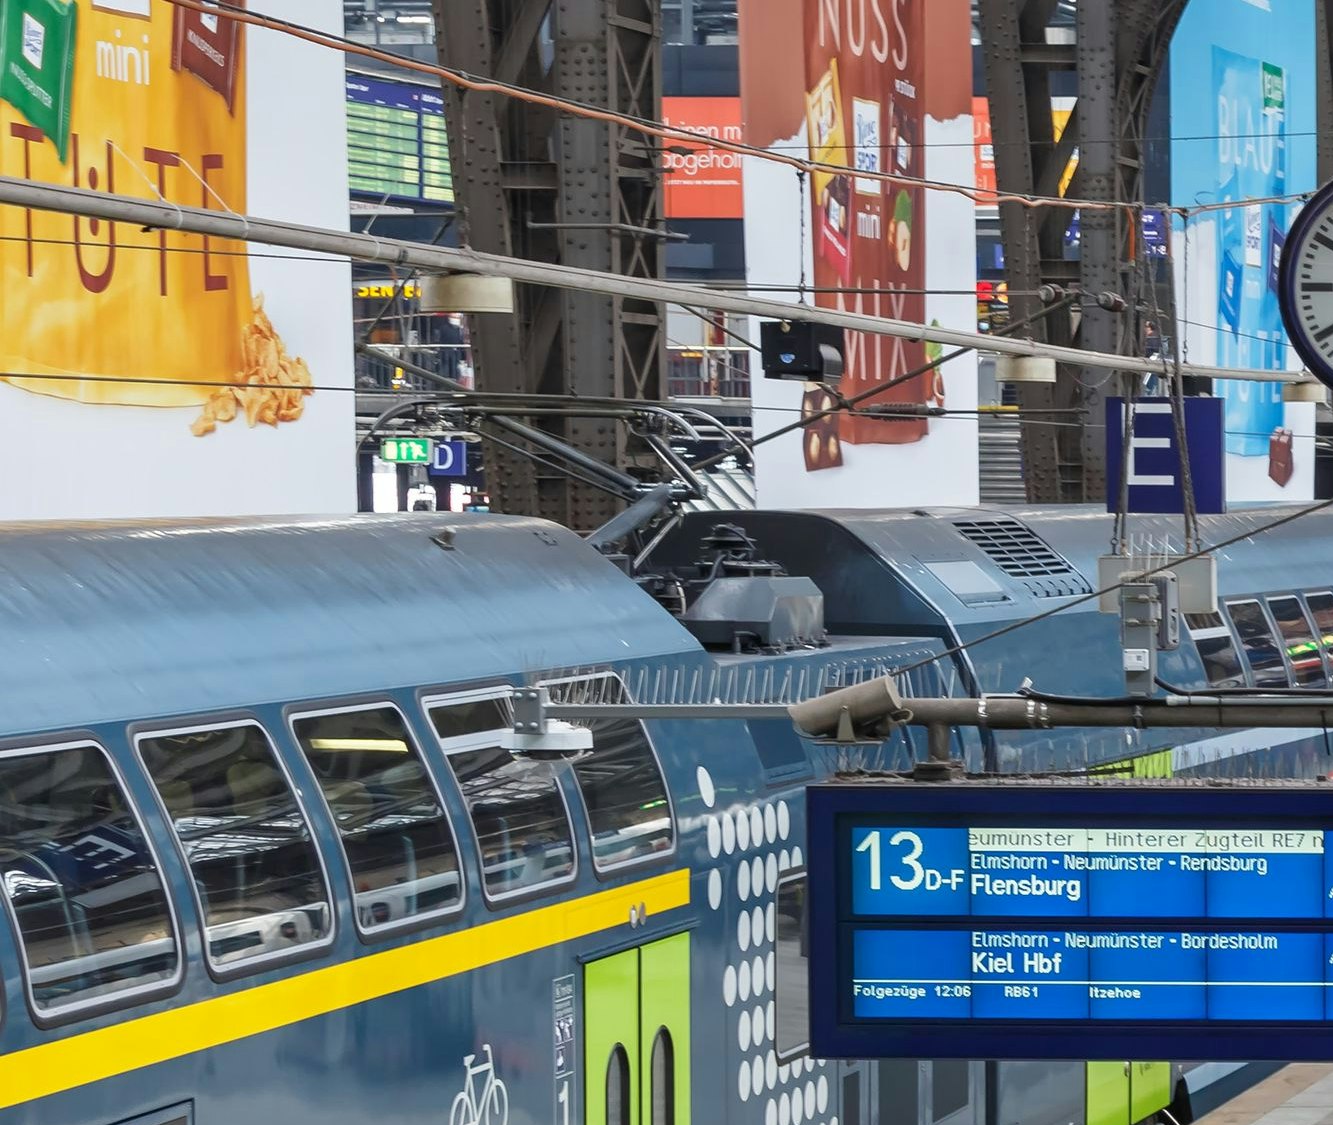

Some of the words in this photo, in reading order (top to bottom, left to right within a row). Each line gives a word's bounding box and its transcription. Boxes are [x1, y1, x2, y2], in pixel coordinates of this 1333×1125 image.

[95, 29, 150, 86] mini
[1127, 404, 1175, 485] E
[434, 444, 453, 470] D
[1105, 831, 1188, 848] Hinterer
[1194, 832, 1264, 853] Zugteil
[1272, 834, 1306, 848] RE7
[855, 830, 925, 891] 13
[924, 869, 965, 892] D-F
[971, 854, 1048, 870] Elmshorn
[1063, 855, 1163, 872] Neumünster
[1180, 856, 1268, 875] Rendsburg
[971, 875, 1081, 900] Flensburg
[972, 931, 1049, 948] Elmshorn
[1065, 932, 1164, 949] Neumünster
[1181, 933, 1278, 949] Bordesholm
[972, 953, 1014, 973] Kiel
[1023, 952, 1062, 974] Hbf
[853, 984, 926, 999] Folgezüge
[934, 985, 972, 998] 12:06
[1004, 986, 1038, 998] RB61
[1089, 987, 1141, 999] Itzehoe
